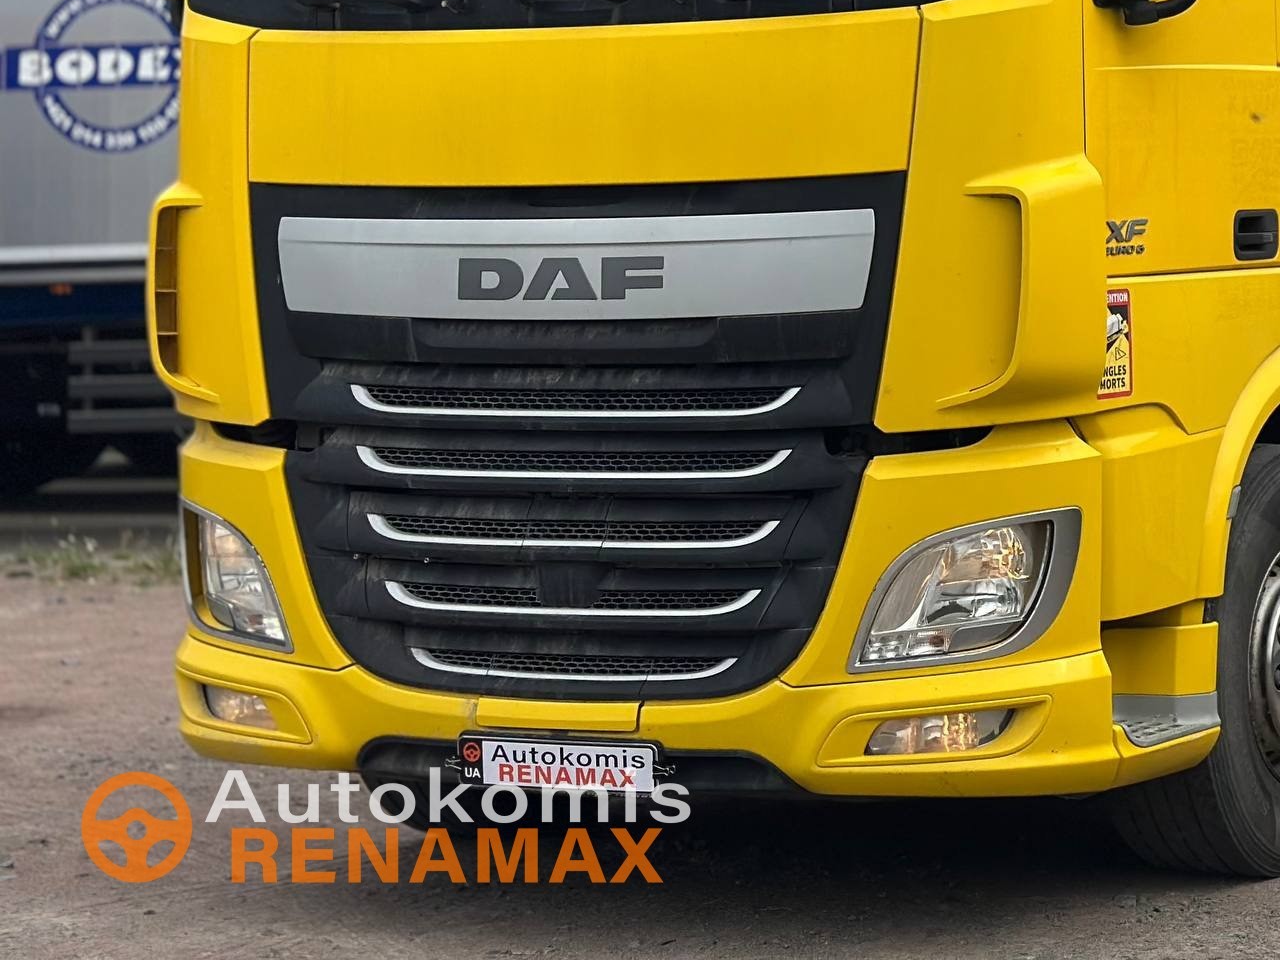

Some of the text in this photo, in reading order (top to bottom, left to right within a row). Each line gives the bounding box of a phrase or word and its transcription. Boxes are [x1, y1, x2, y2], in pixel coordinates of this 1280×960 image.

[17, 45, 181, 87] BODE
[1106, 219, 1148, 244] XF
[457, 256, 664, 301] DAF
[491, 744, 646, 770] Autokomis
[464, 767, 481, 778] UA
[498, 763, 635, 788] RENAMAX
